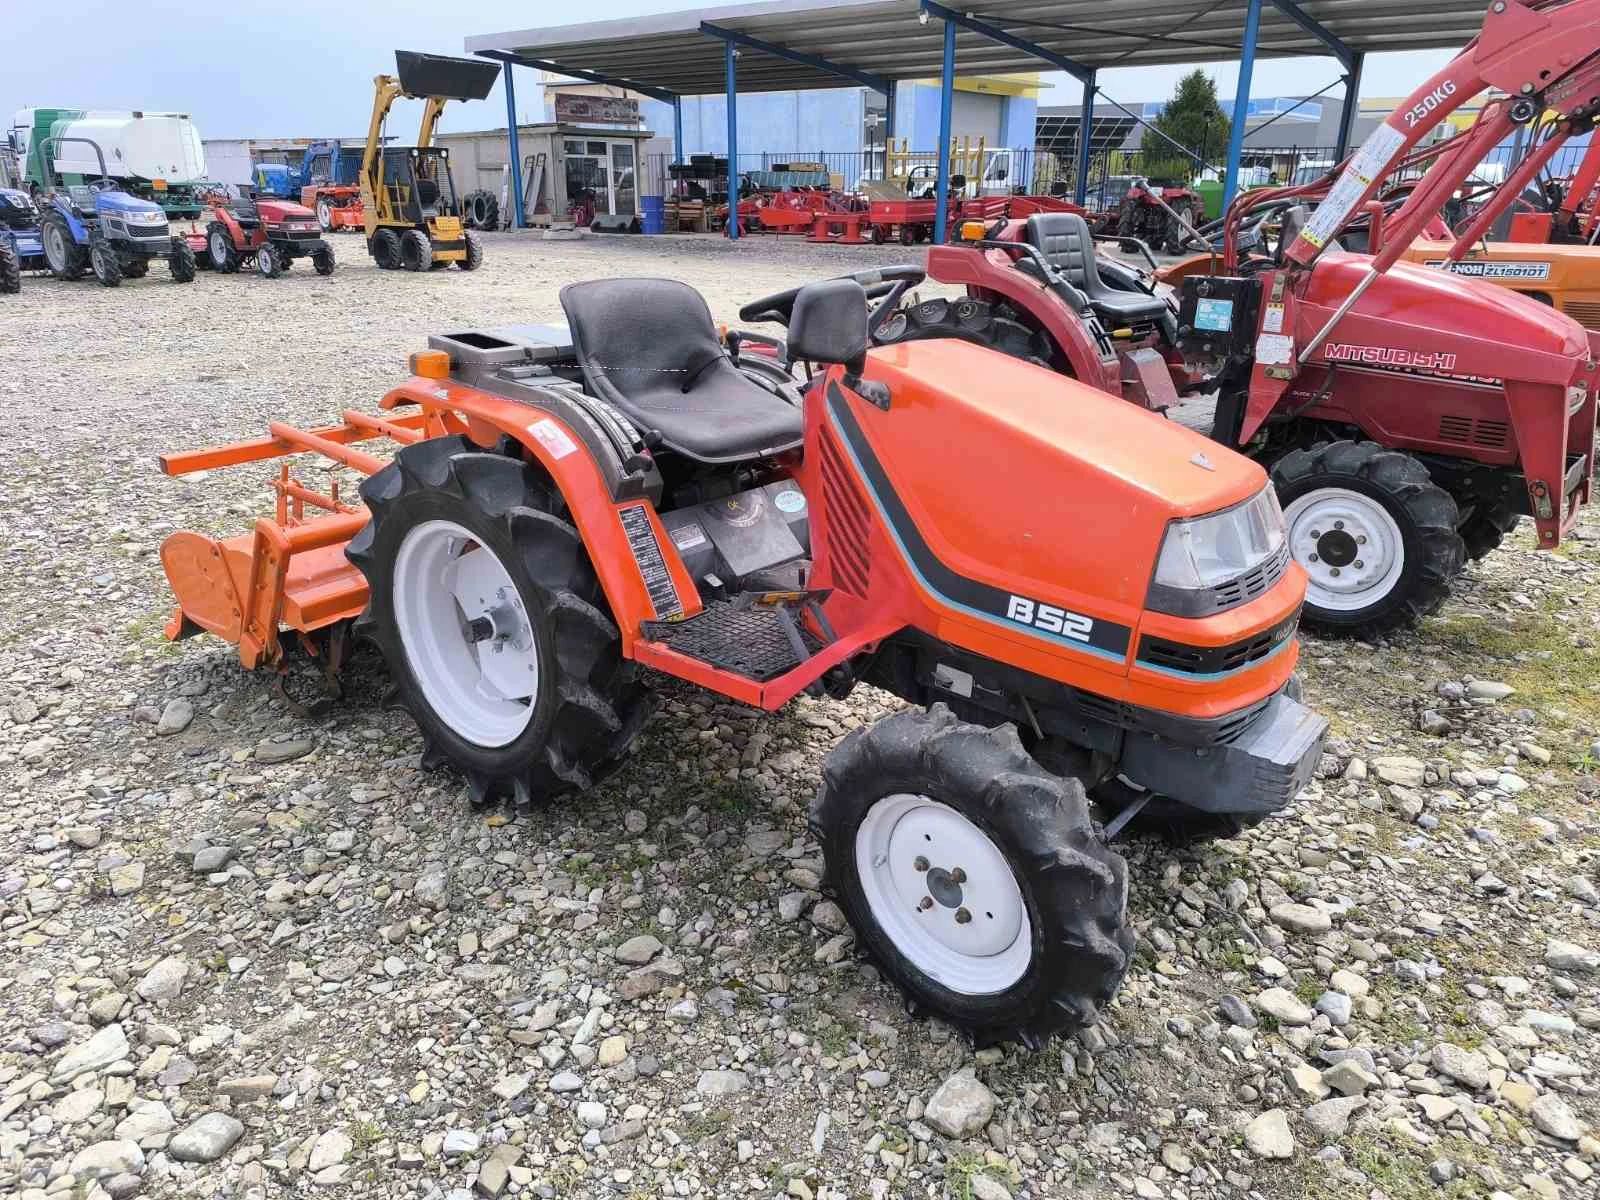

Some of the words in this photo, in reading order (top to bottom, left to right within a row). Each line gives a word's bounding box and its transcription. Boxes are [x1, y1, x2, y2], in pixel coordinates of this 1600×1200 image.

[1405, 80, 1456, 127] 250KG
[1325, 343, 1456, 369] MITSUBISHI
[1006, 595, 1094, 642] B52
